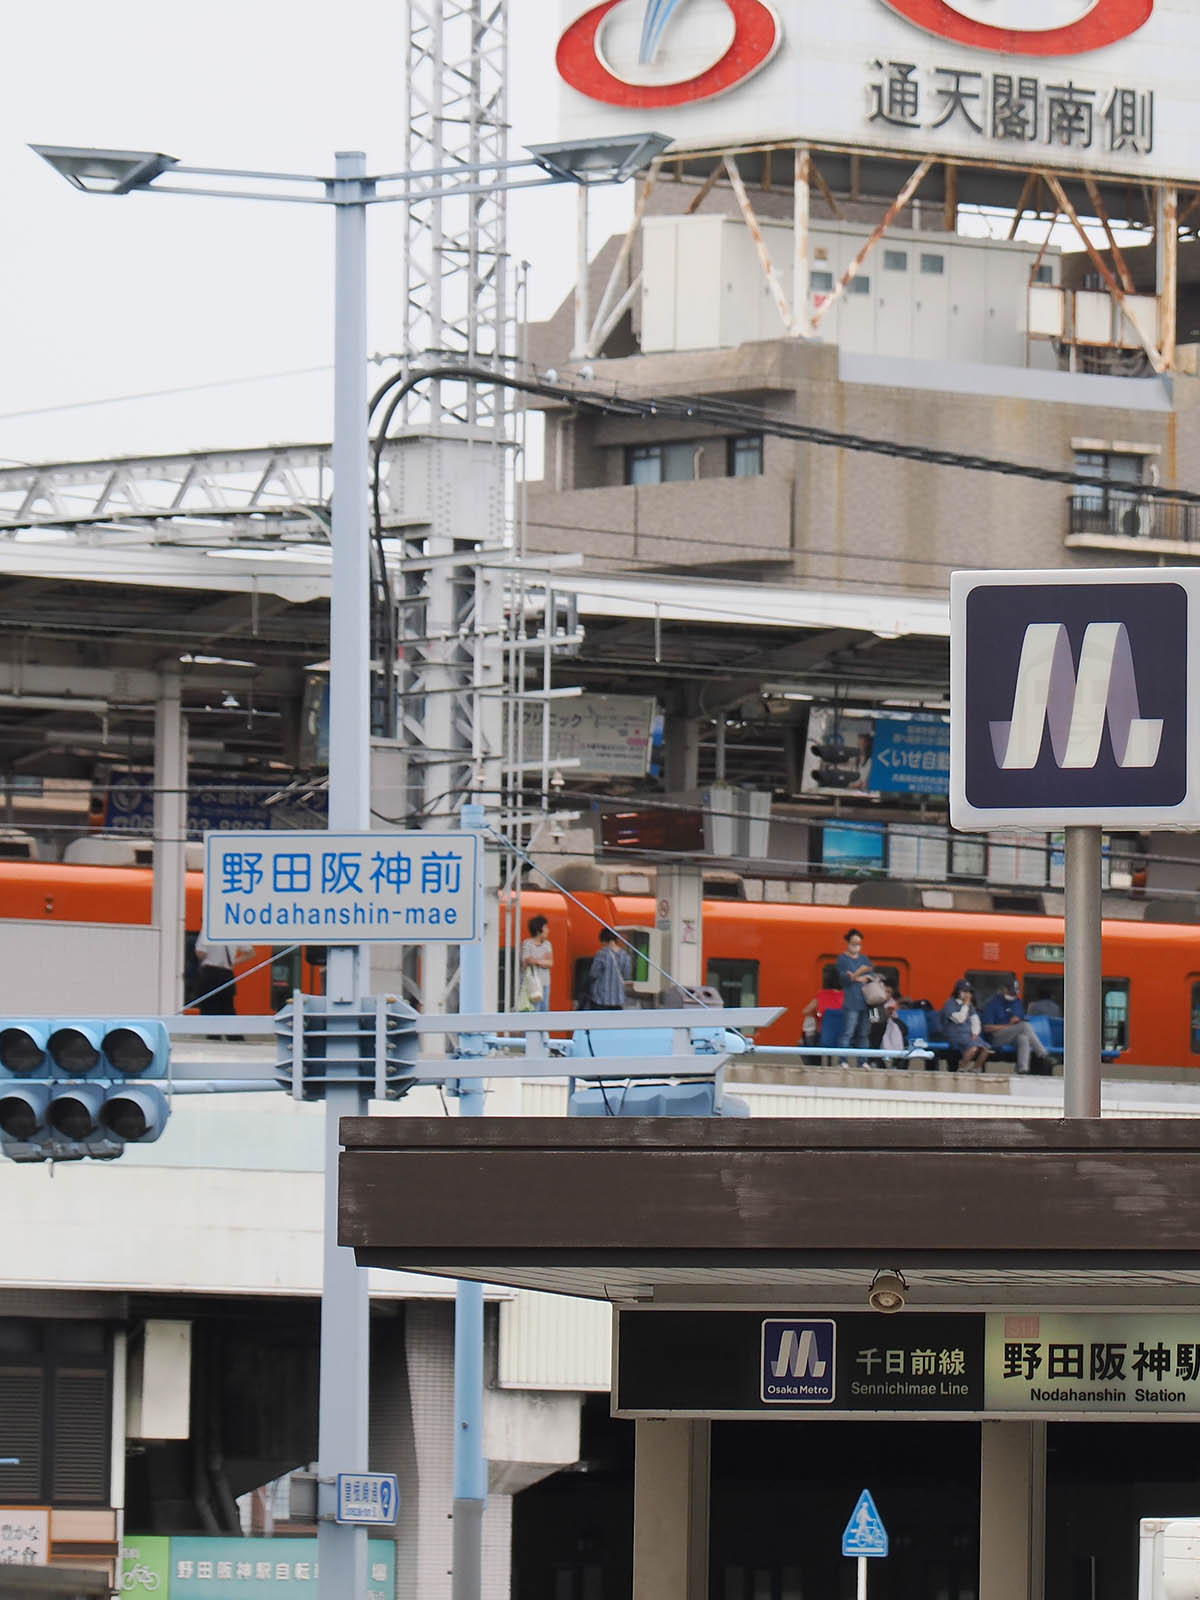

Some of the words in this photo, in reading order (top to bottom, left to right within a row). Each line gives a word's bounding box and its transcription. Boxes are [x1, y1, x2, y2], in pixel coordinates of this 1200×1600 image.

[867, 59, 1154, 154] 通天閣南側
[221, 851, 462, 895] 野田阪神前
[224, 902, 458, 925] Nodahanshin-mae
[855, 1348, 966, 1377] 千日前線
[767, 1385, 798, 1395] Osaka
[799, 1385, 829, 1395] Metro
[851, 1382, 937, 1396] Sennichimae
[940, 1382, 969, 1396] Line
[1030, 1388, 1127, 1402] Nodahanshin
[1135, 1388, 1186, 1402] Station
